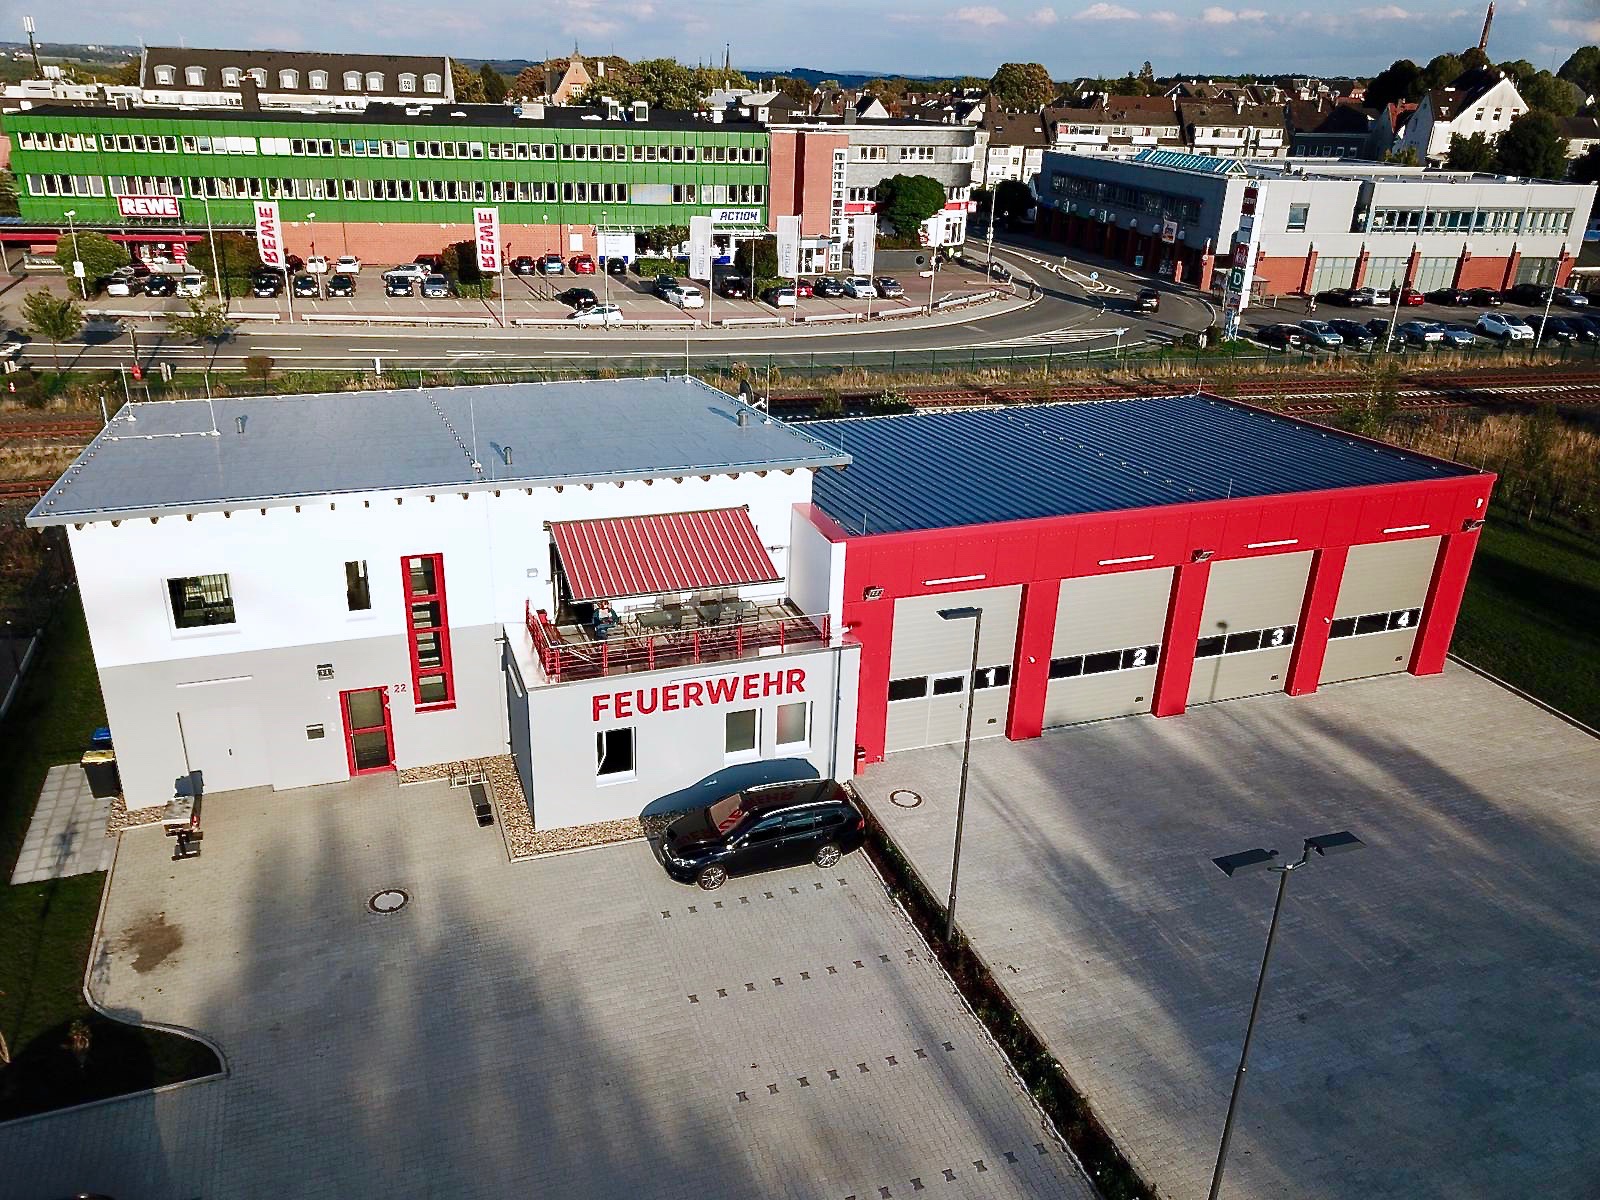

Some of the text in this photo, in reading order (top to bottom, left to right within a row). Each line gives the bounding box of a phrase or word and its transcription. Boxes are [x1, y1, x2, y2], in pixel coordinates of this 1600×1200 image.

[121, 198, 177, 215] REWE
[720, 212, 757, 222] ACTION
[259, 207, 279, 263] REWE
[478, 212, 496, 268] REWE
[1233, 271, 1242, 286] D
[1396, 611, 1410, 628] 4
[1270, 629, 1284, 646] 3
[1132, 648, 1147, 667] 2
[985, 668, 996, 687] 1
[393, 682, 407, 694] 22
[592, 668, 806, 722] FEUERWEHR
